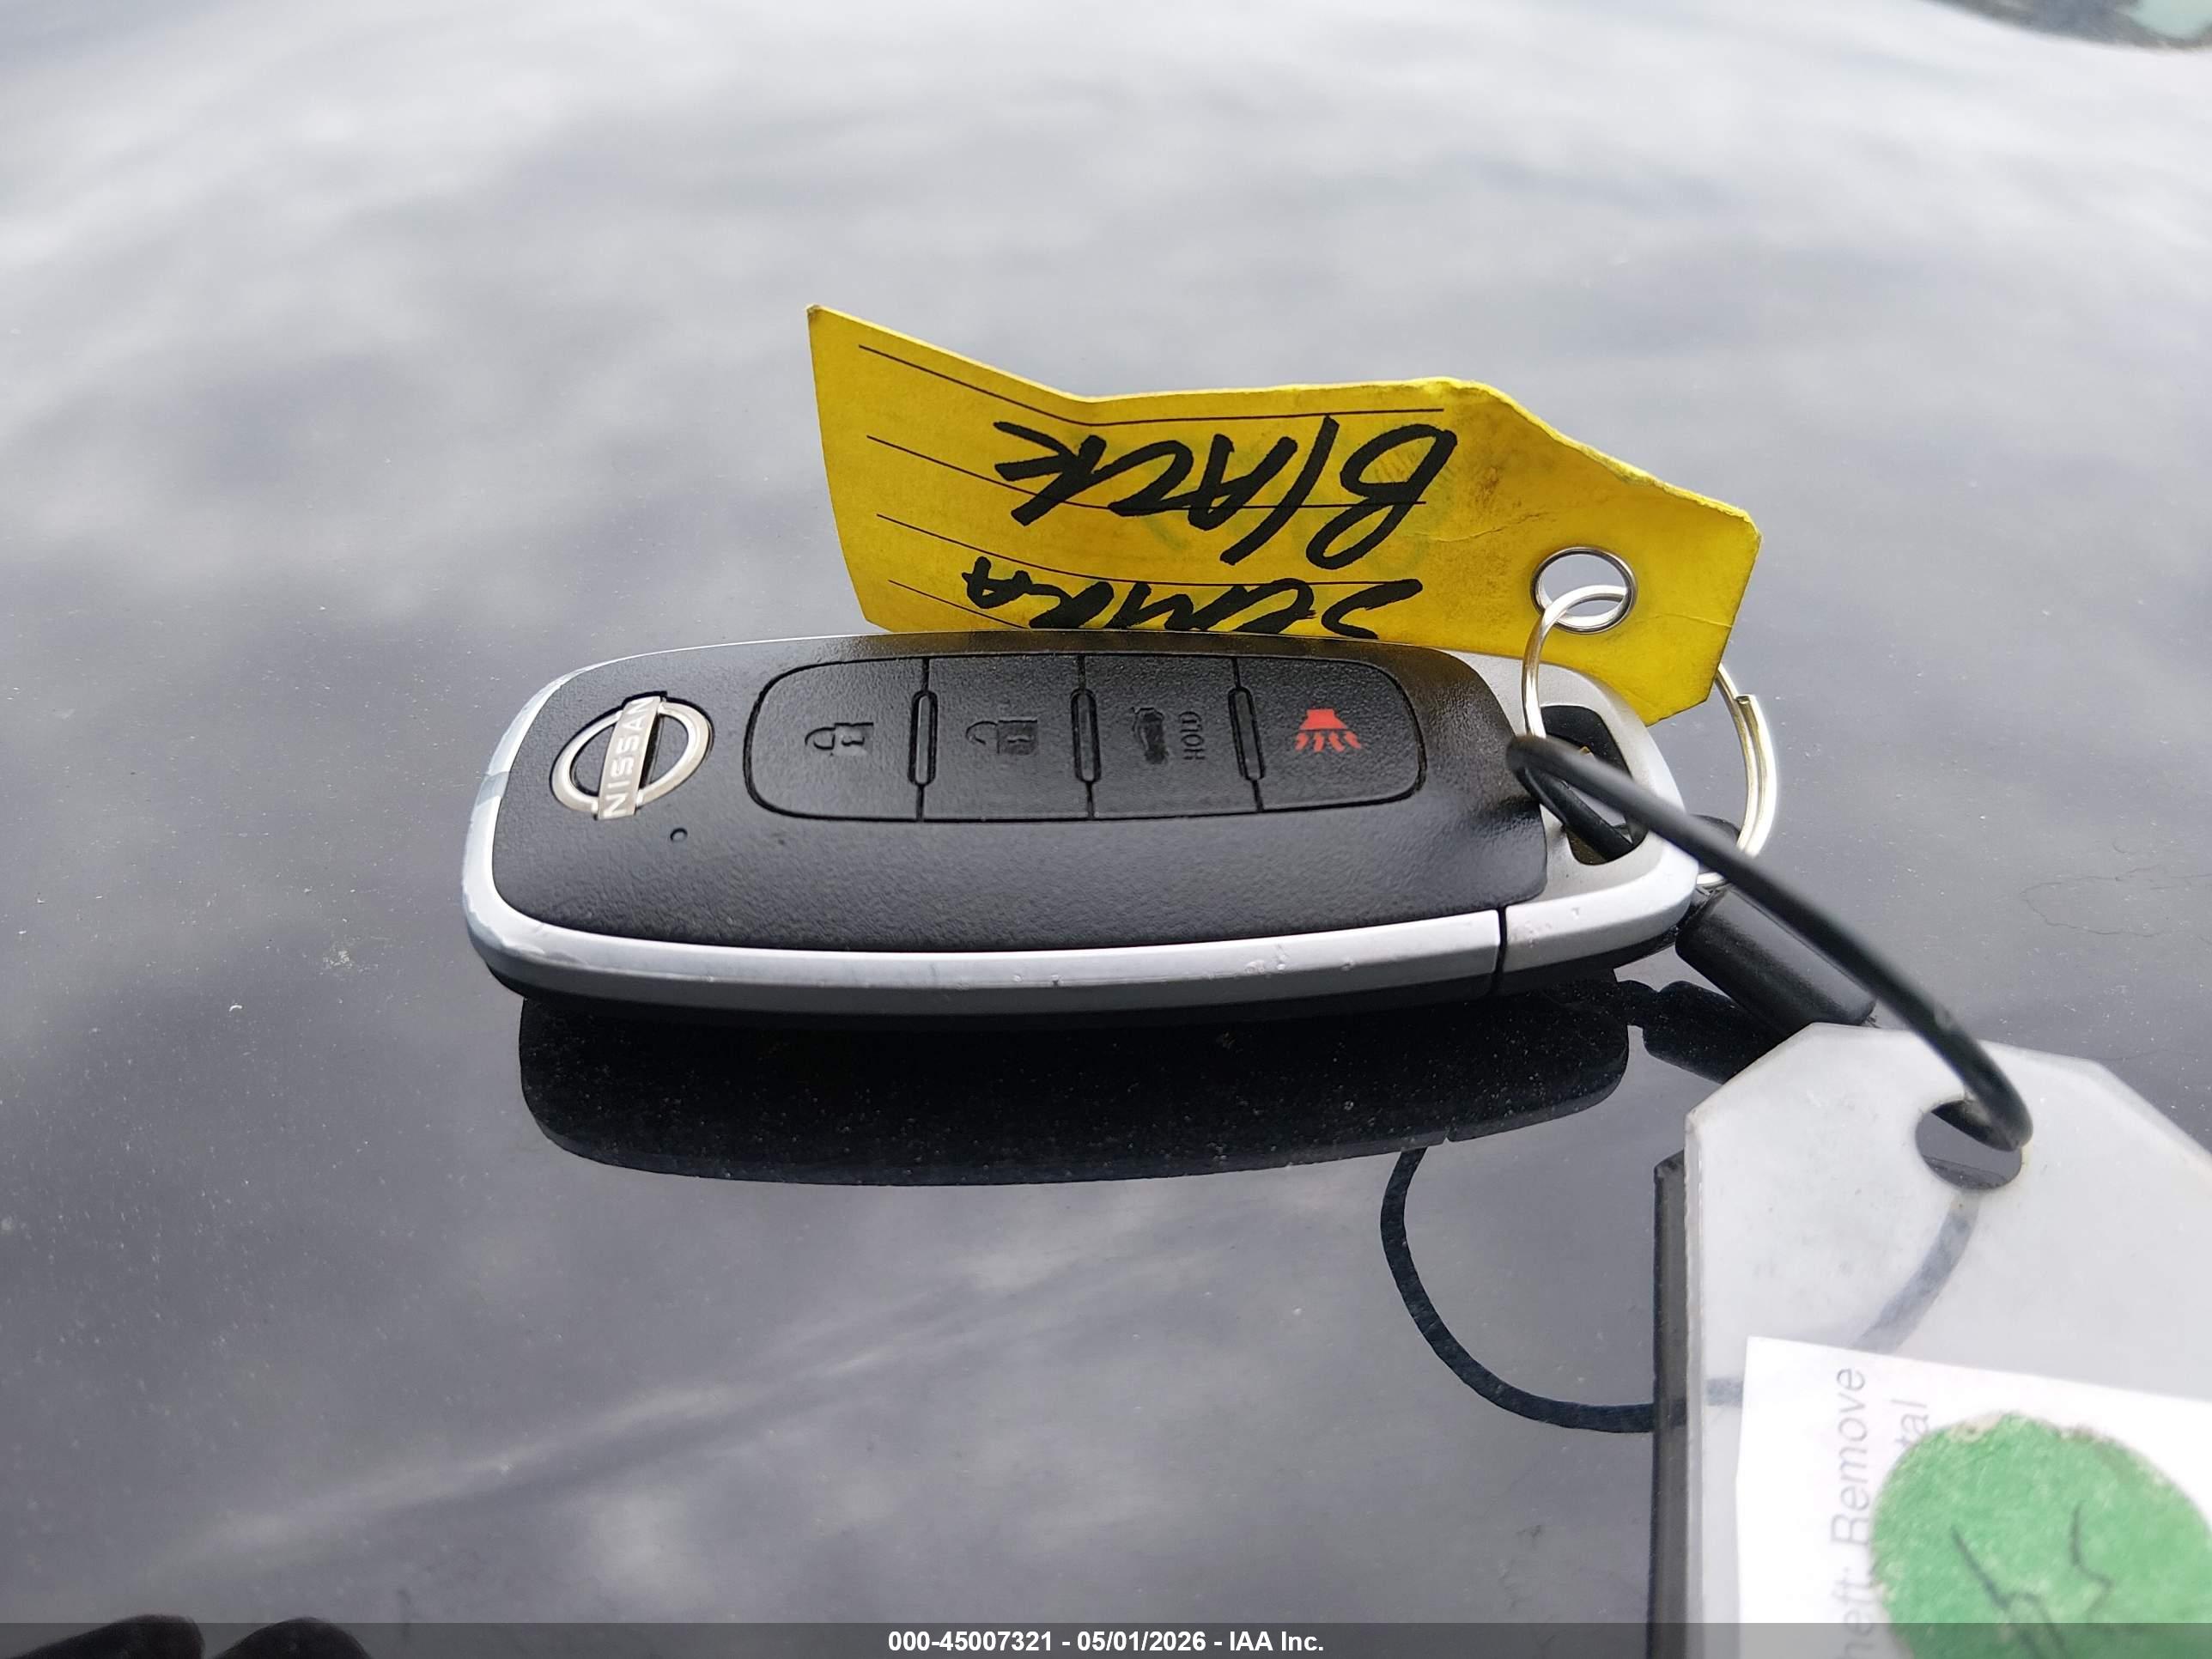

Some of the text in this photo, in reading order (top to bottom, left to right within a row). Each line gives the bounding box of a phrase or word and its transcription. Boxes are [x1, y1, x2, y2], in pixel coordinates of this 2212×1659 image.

[601, 696, 659, 817] NISSAN
[1178, 710, 1206, 762] HOLD
[1830, 1367, 1871, 1546] Remove
